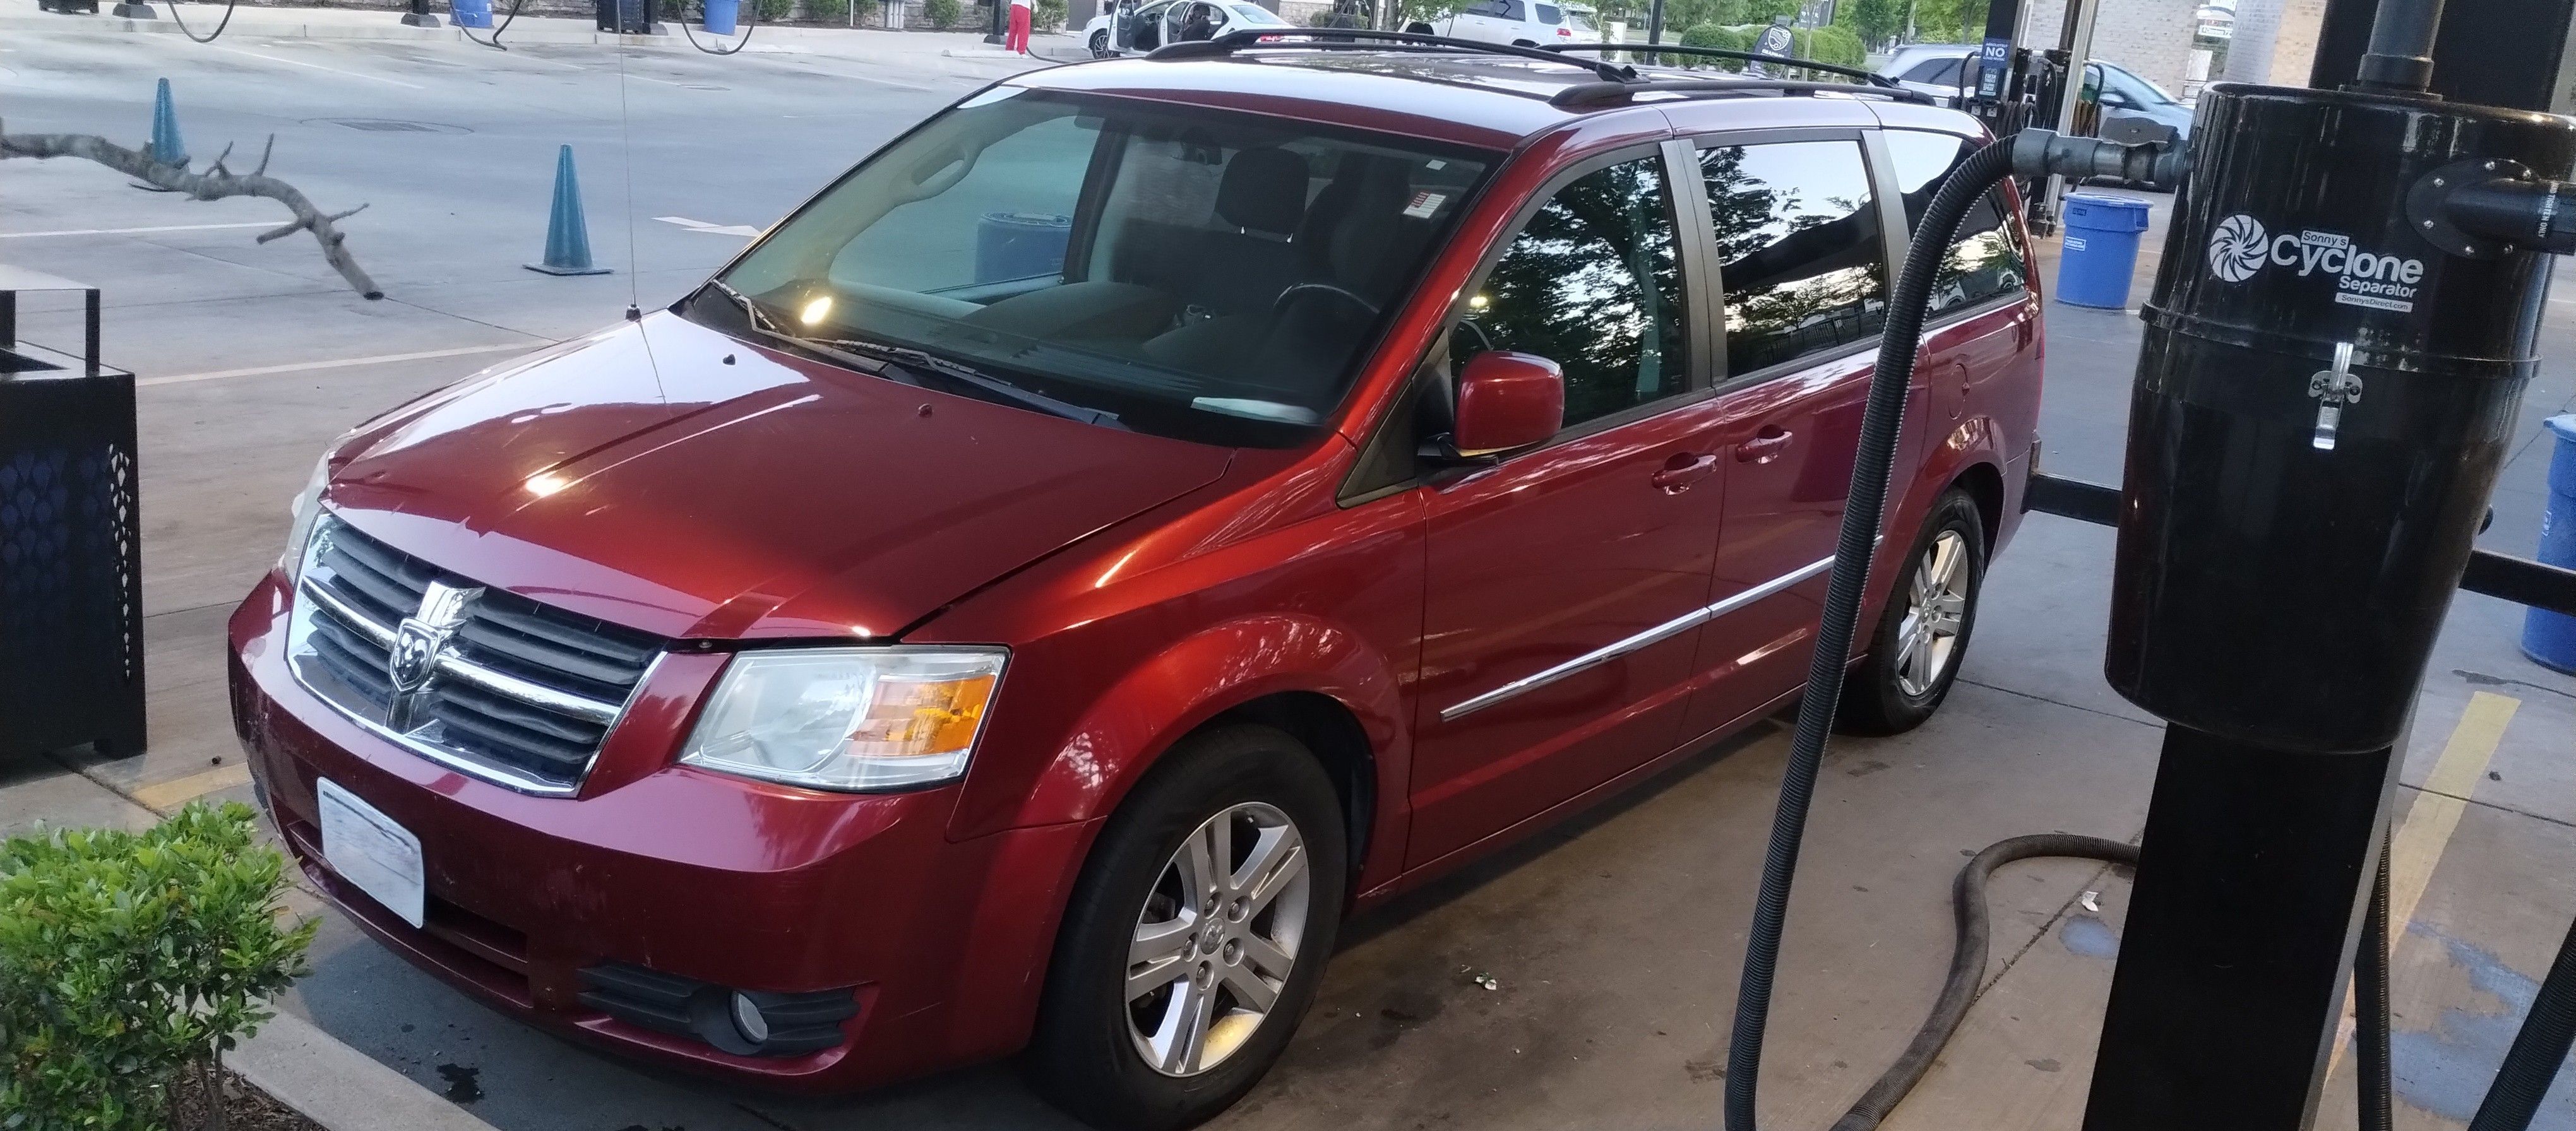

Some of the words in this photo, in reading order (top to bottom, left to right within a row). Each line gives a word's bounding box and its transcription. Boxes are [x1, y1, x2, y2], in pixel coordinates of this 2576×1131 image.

[1986, 47, 2005, 57] NO
[2303, 231, 2347, 246] Sonnys
[2538, 222, 2548, 238] ONLY
[2271, 234, 2424, 284] Cyclone
[2339, 275, 2417, 298] Separator
[2340, 293, 2409, 311] SonnysDirect.com
